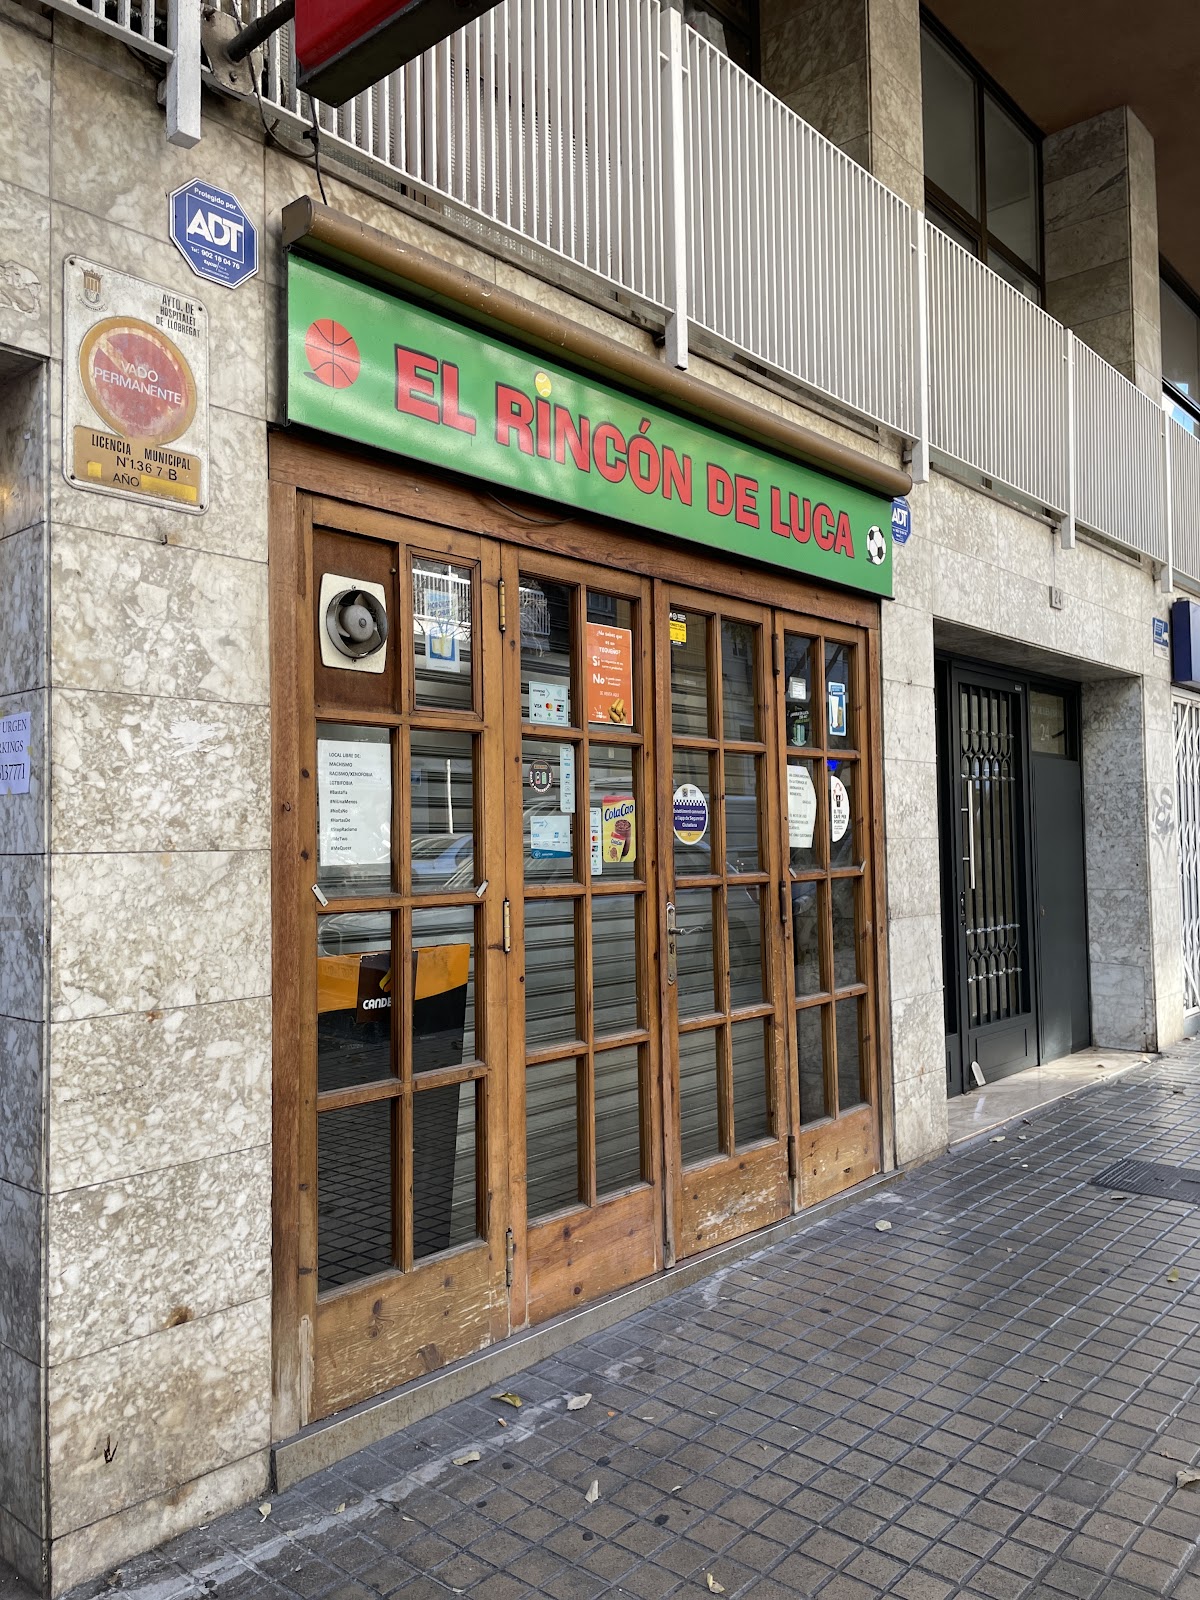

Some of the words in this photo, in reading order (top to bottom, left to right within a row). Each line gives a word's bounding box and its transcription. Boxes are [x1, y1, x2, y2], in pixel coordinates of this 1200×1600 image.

[194, 187, 225, 205] Protegido
[225, 201, 237, 211] por
[186, 208, 244, 253] ADT
[201, 249, 213, 260] 902
[223, 258, 231, 267] 04
[160, 305, 196, 327] HOSPITALET
[161, 294, 183, 312] AYTO.
[185, 302, 195, 316] DE
[155, 315, 164, 326] DE
[167, 319, 200, 339] LLOBREGAT
[120, 361, 158, 383] VADO
[93, 367, 182, 405] PERMANENTE
[91, 434, 132, 456] LICENCIA
[144, 448, 191, 471] MUNICIPAL
[394, 343, 477, 436] EL
[706, 462, 760, 529] DE
[770, 485, 855, 559] LUCA
[112, 473, 140, 487] AÑO
[892, 507, 908, 527] ADT
[592, 673, 605, 685] No
[0, 740, 24, 754] KINGS
[0, 763, 25, 781] 137771
[604, 803, 634, 822] ColaCao
